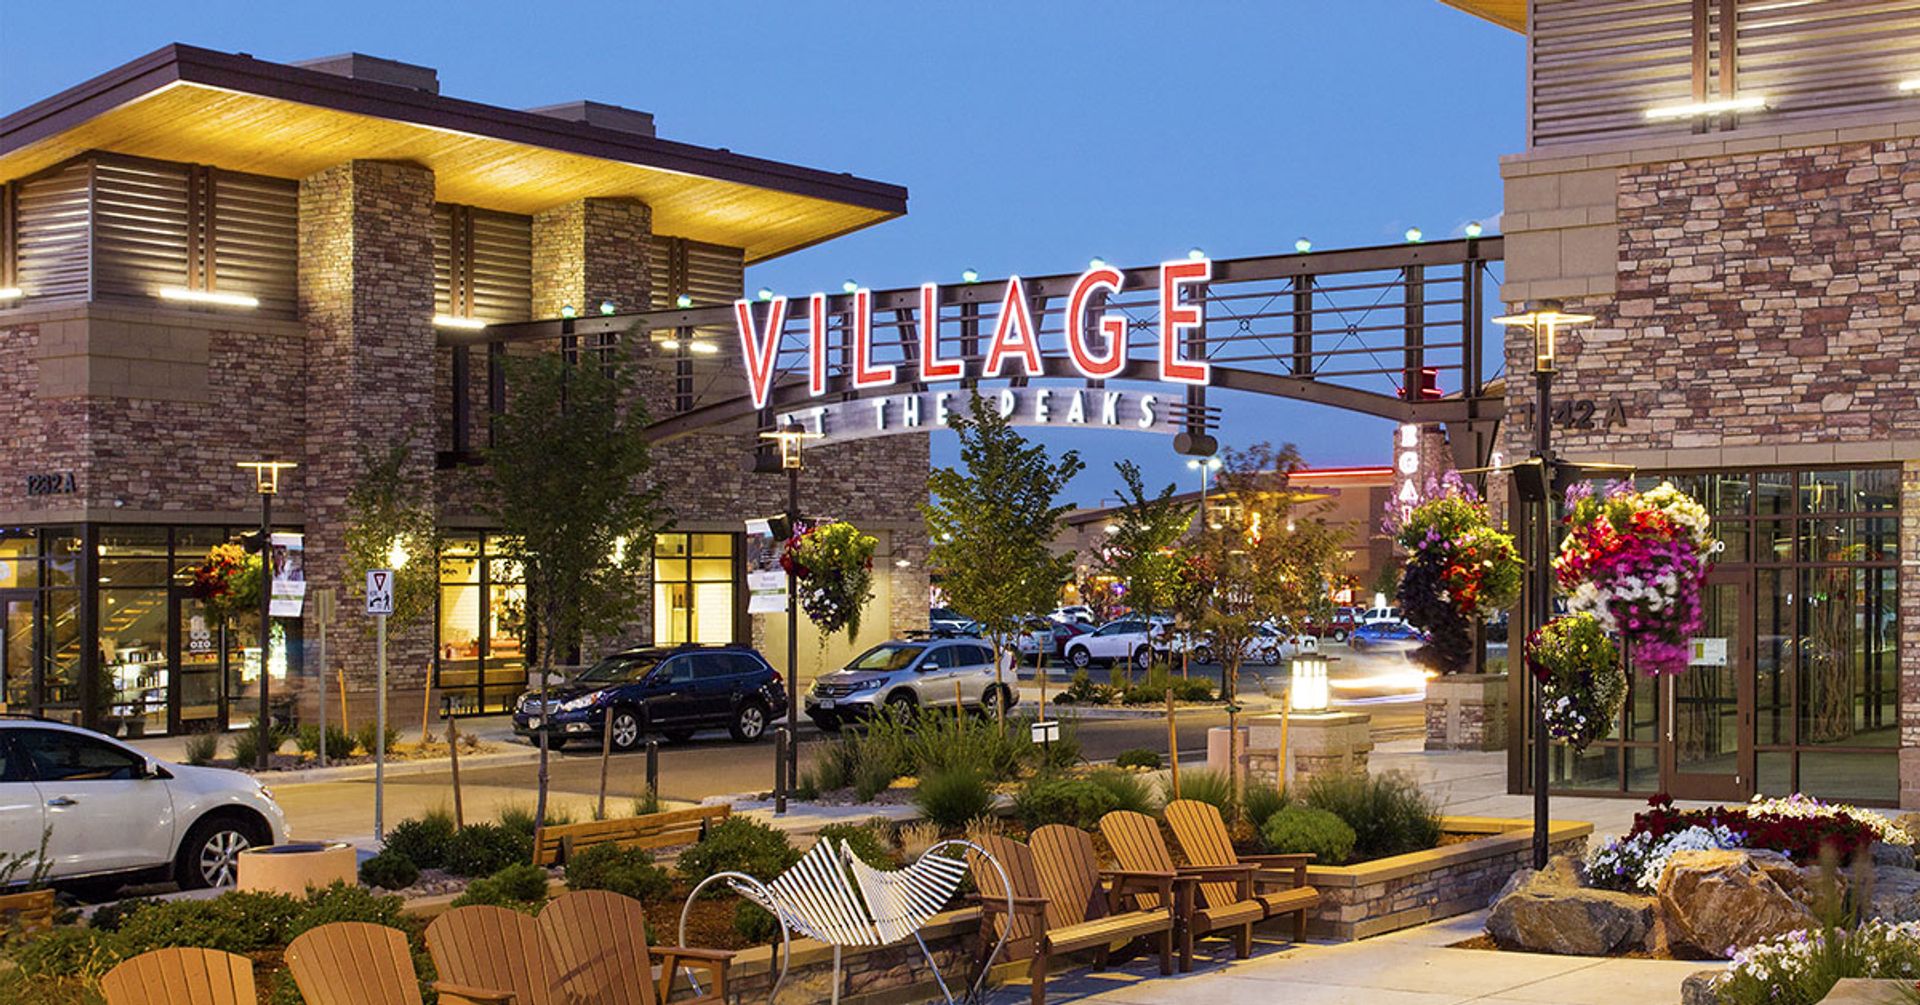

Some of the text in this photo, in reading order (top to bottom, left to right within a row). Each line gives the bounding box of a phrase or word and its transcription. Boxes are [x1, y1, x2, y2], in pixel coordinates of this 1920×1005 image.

[734, 258, 1211, 410] VILLAGE
[873, 392, 952, 431] THE
[1000, 388, 1158, 429] PEAKS
[1523, 399, 1628, 433] 142 A
[64, 471, 77, 494] A
